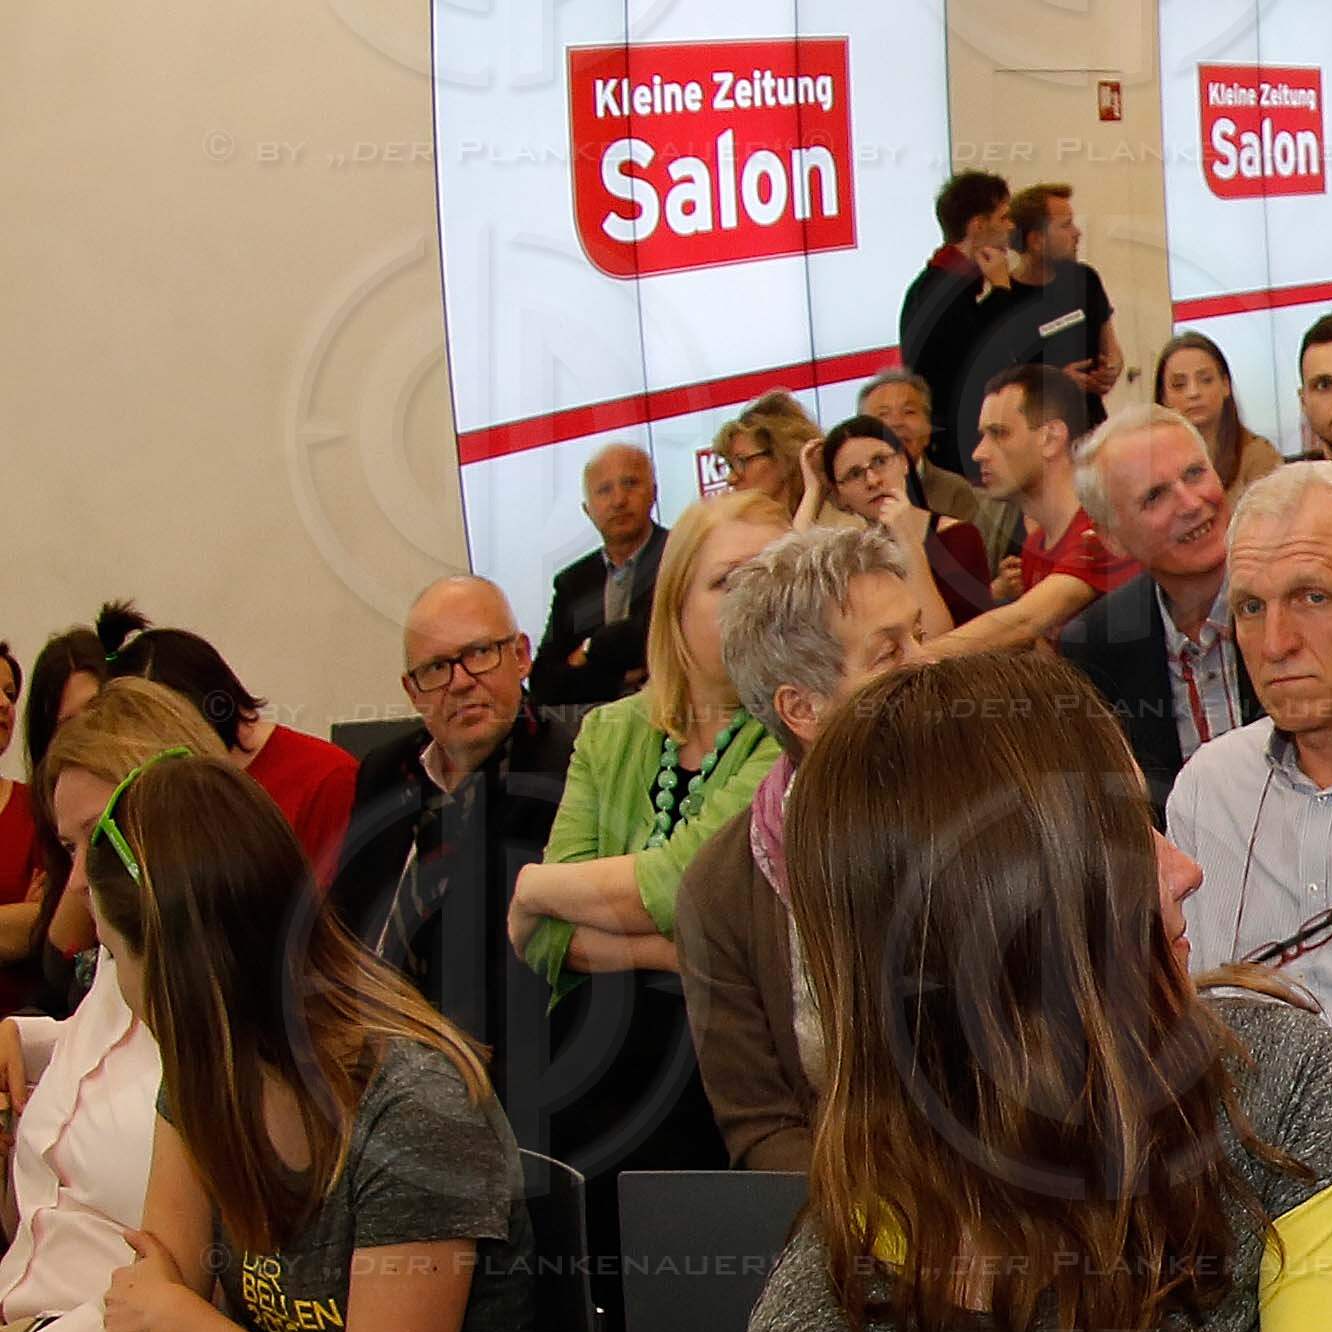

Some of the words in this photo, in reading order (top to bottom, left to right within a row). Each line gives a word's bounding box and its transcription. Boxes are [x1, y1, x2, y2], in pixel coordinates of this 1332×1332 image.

[594, 74, 703, 118] Kleine
[712, 69, 833, 112] Zeitung
[1208, 82, 1257, 107] Kleine
[1260, 83, 1317, 111] Zeitung
[1211, 117, 1319, 180] Salon
[601, 128, 839, 243] Salon
